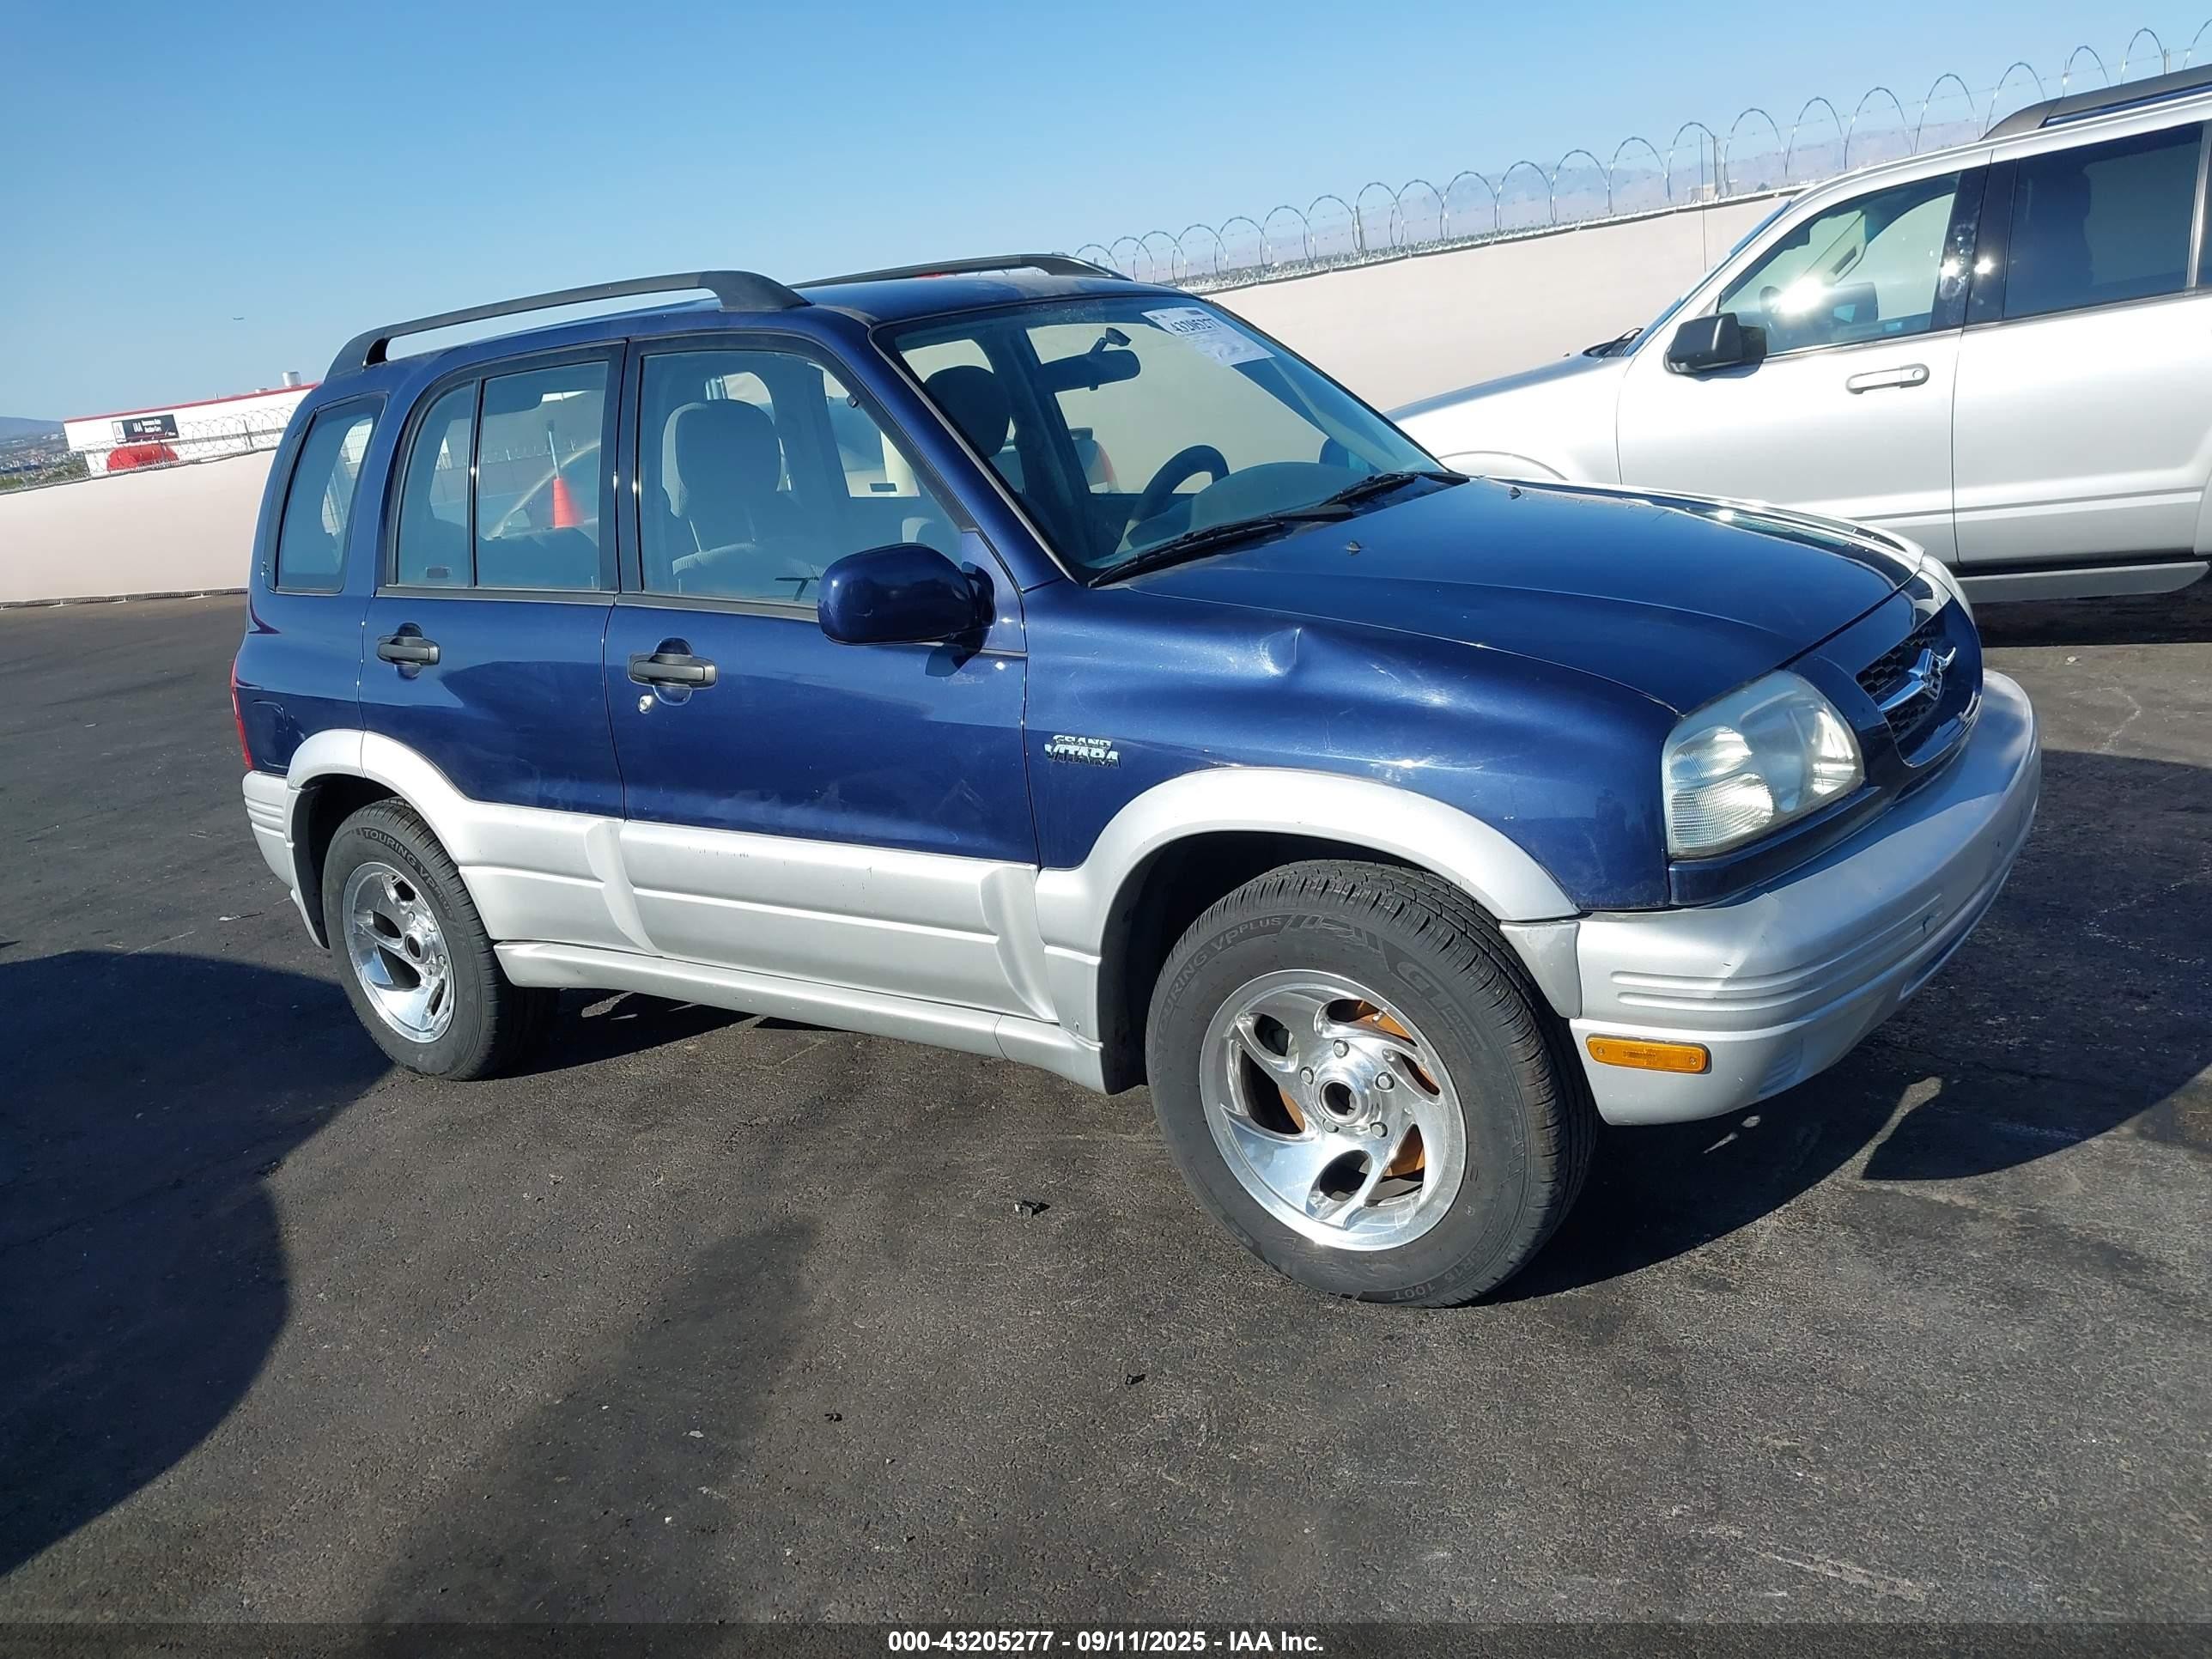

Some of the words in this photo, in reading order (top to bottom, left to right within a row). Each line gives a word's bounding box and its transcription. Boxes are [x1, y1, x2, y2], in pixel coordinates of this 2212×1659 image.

[1044, 744, 1121, 769] VITARA
[364, 829, 417, 866] TOURING
[1392, 1283, 1436, 1301] 100T
